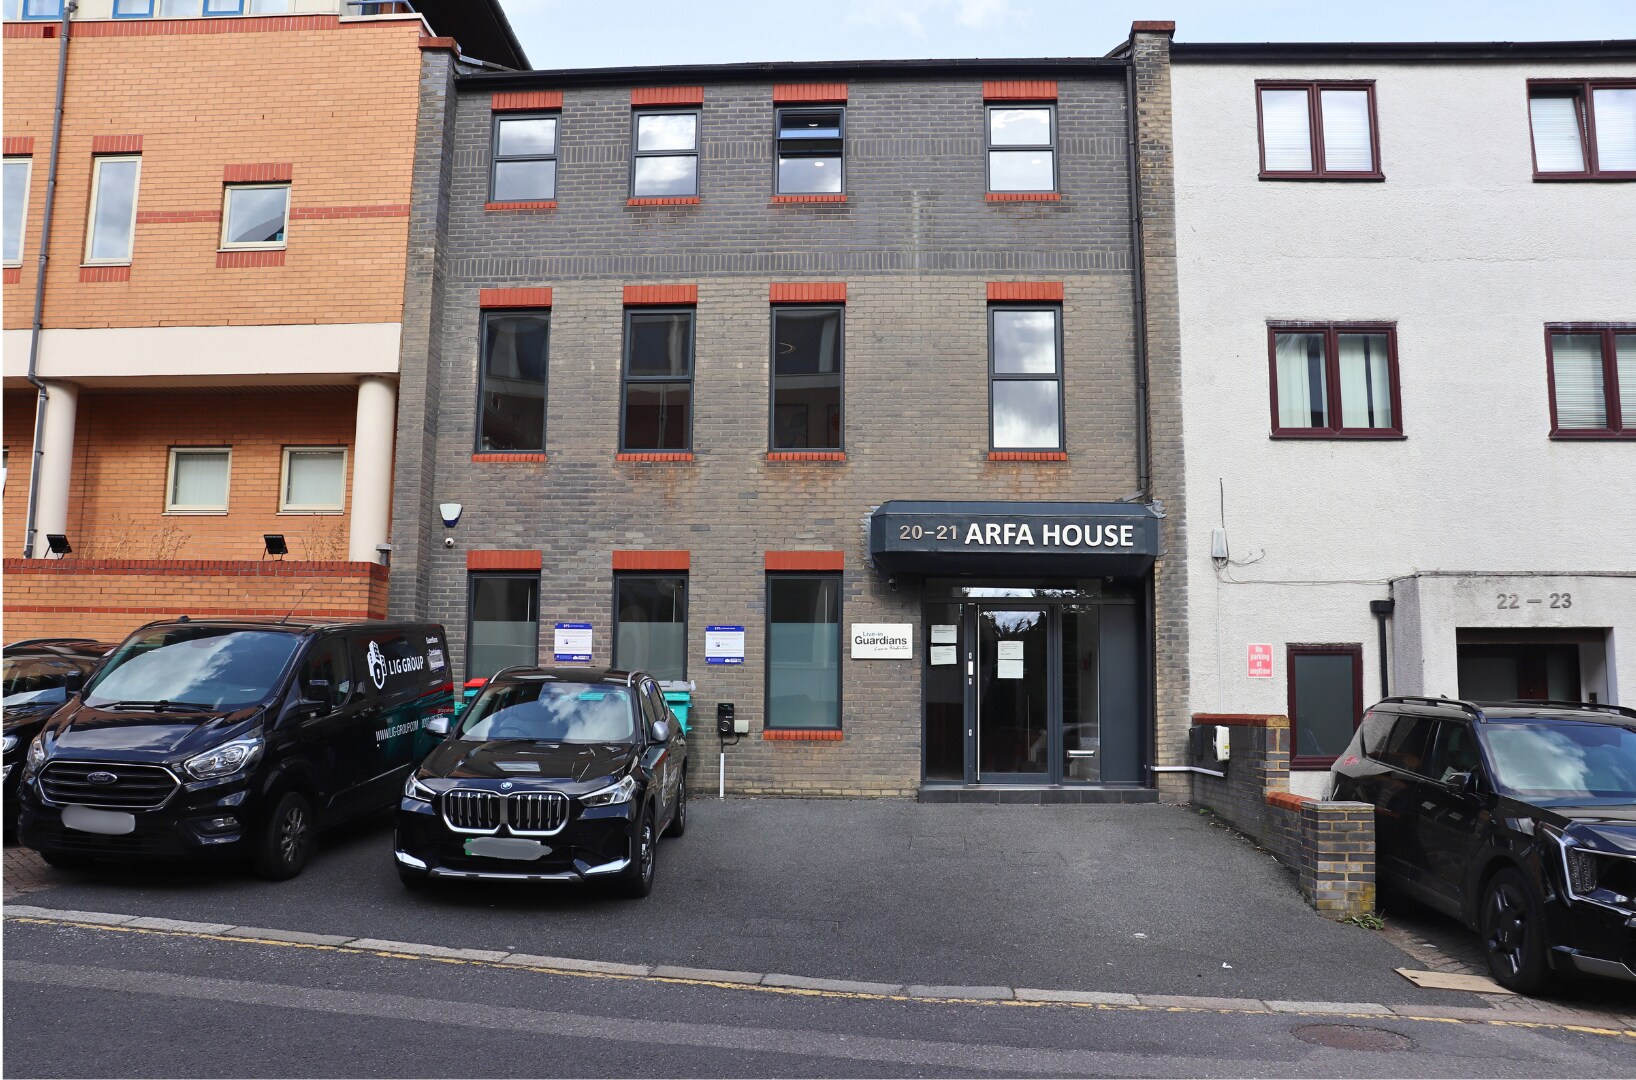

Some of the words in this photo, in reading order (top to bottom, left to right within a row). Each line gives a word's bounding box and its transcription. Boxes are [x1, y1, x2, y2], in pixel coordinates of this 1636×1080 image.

[899, 525, 957, 540] 20-21
[964, 523, 1035, 545] ARFA
[1042, 524, 1134, 547] HOUSE
[1496, 592, 1520, 609] 22
[1549, 592, 1572, 609] 23
[854, 635, 908, 645] Guardians
[388, 658, 402, 675] LIG
[401, 655, 424, 673] GROUP
